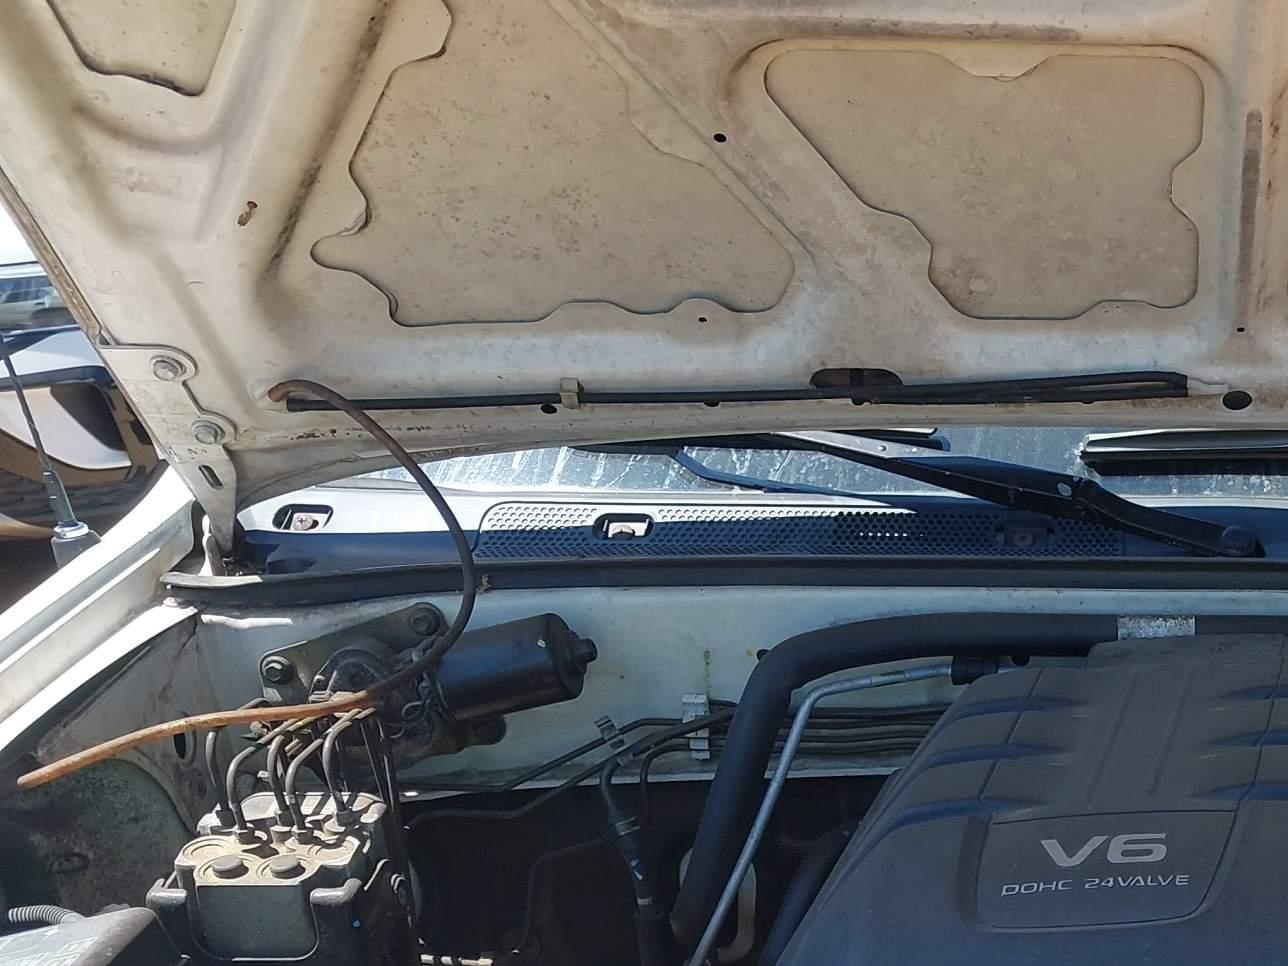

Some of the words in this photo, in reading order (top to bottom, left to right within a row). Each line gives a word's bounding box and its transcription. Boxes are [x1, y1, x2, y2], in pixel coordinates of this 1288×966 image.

[1040, 833, 1168, 867] V6
[1001, 879, 1063, 896] DOHC
[1084, 874, 1190, 889] 24VALVE
